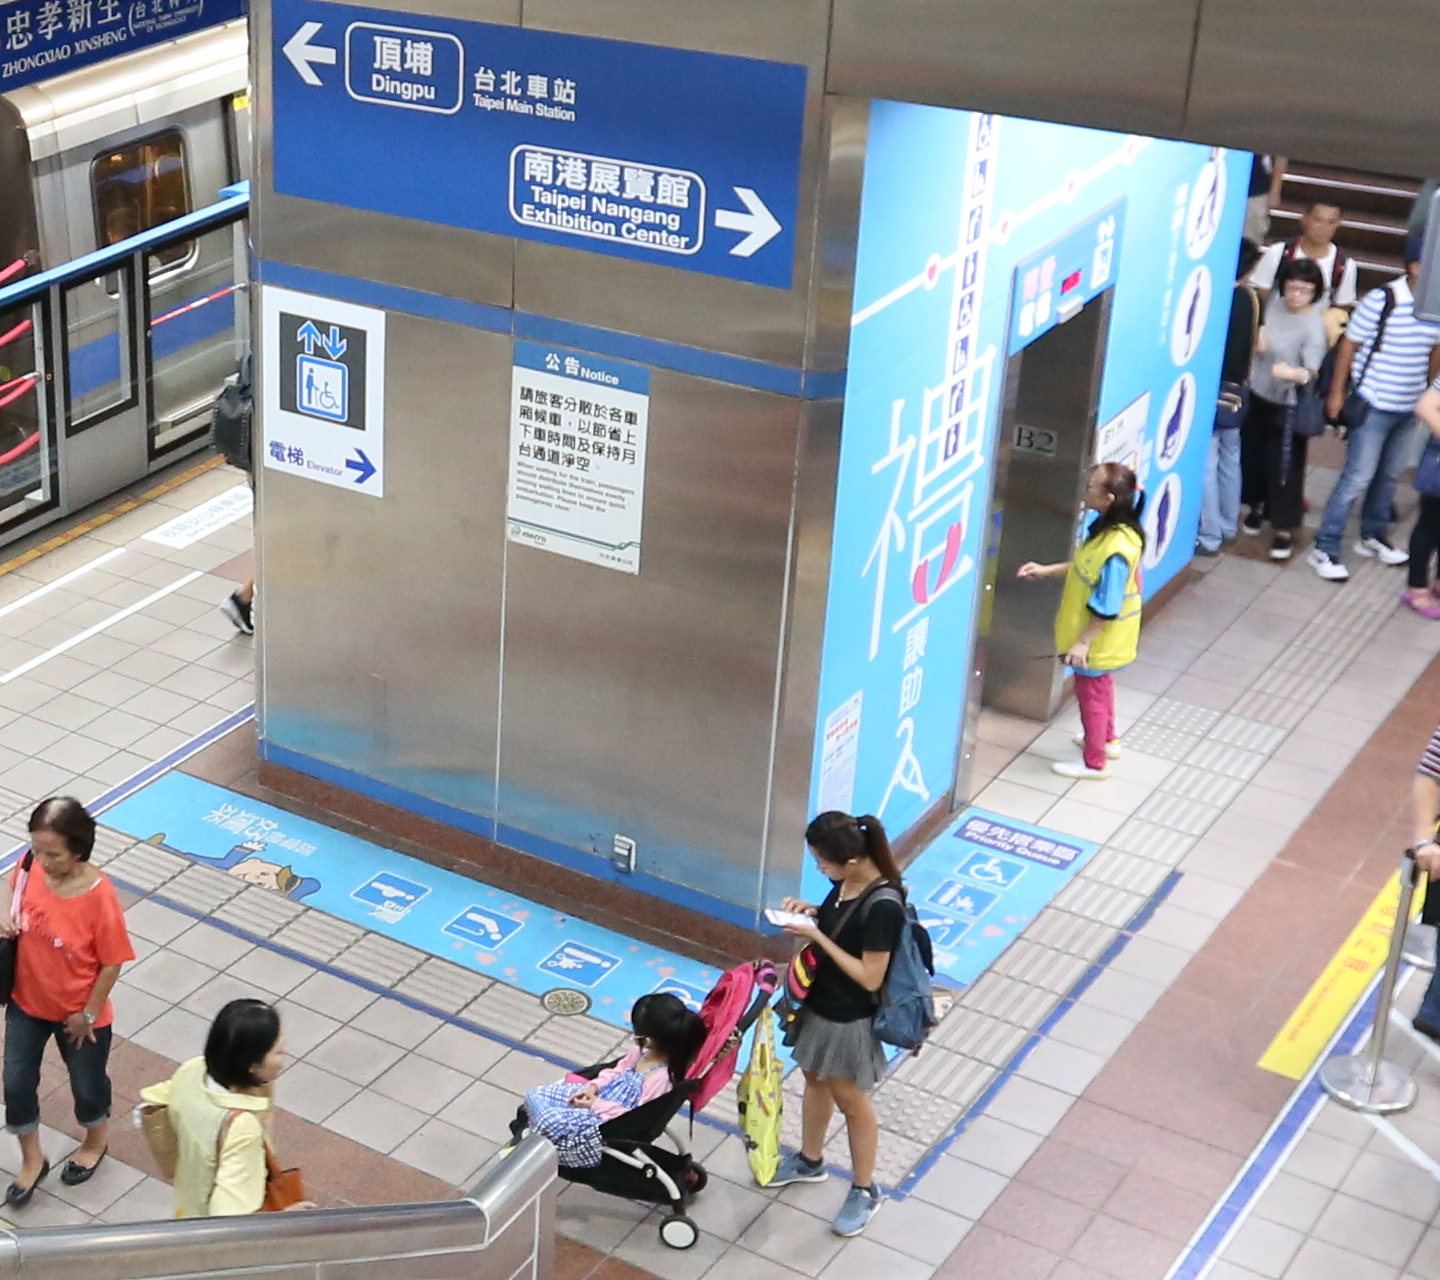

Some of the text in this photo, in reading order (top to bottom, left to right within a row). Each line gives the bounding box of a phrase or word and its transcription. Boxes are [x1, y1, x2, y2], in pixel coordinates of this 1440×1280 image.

[2, 27, 127, 78] ZHONGXIAO XINSHENG
[373, 36, 434, 76] 頂埔
[371, 73, 436, 100] Dingpu
[474, 66, 577, 105] 台北車站
[472, 92, 576, 122] Taipei Main Station
[524, 152, 691, 208] 南港展覽館
[522, 204, 690, 249] Exhibition Center
[530, 185, 681, 231] Taipei Nangang
[545, 352, 619, 385] 公告 Notice
[520, 386, 638, 426] 請旅客分散於各車
[269, 440, 343, 477] 電梯 Elevator
[519, 423, 637, 465] 下車時間及保持月
[1016, 426, 1054, 452] B2
[965, 830, 1061, 865] Priority Queue
